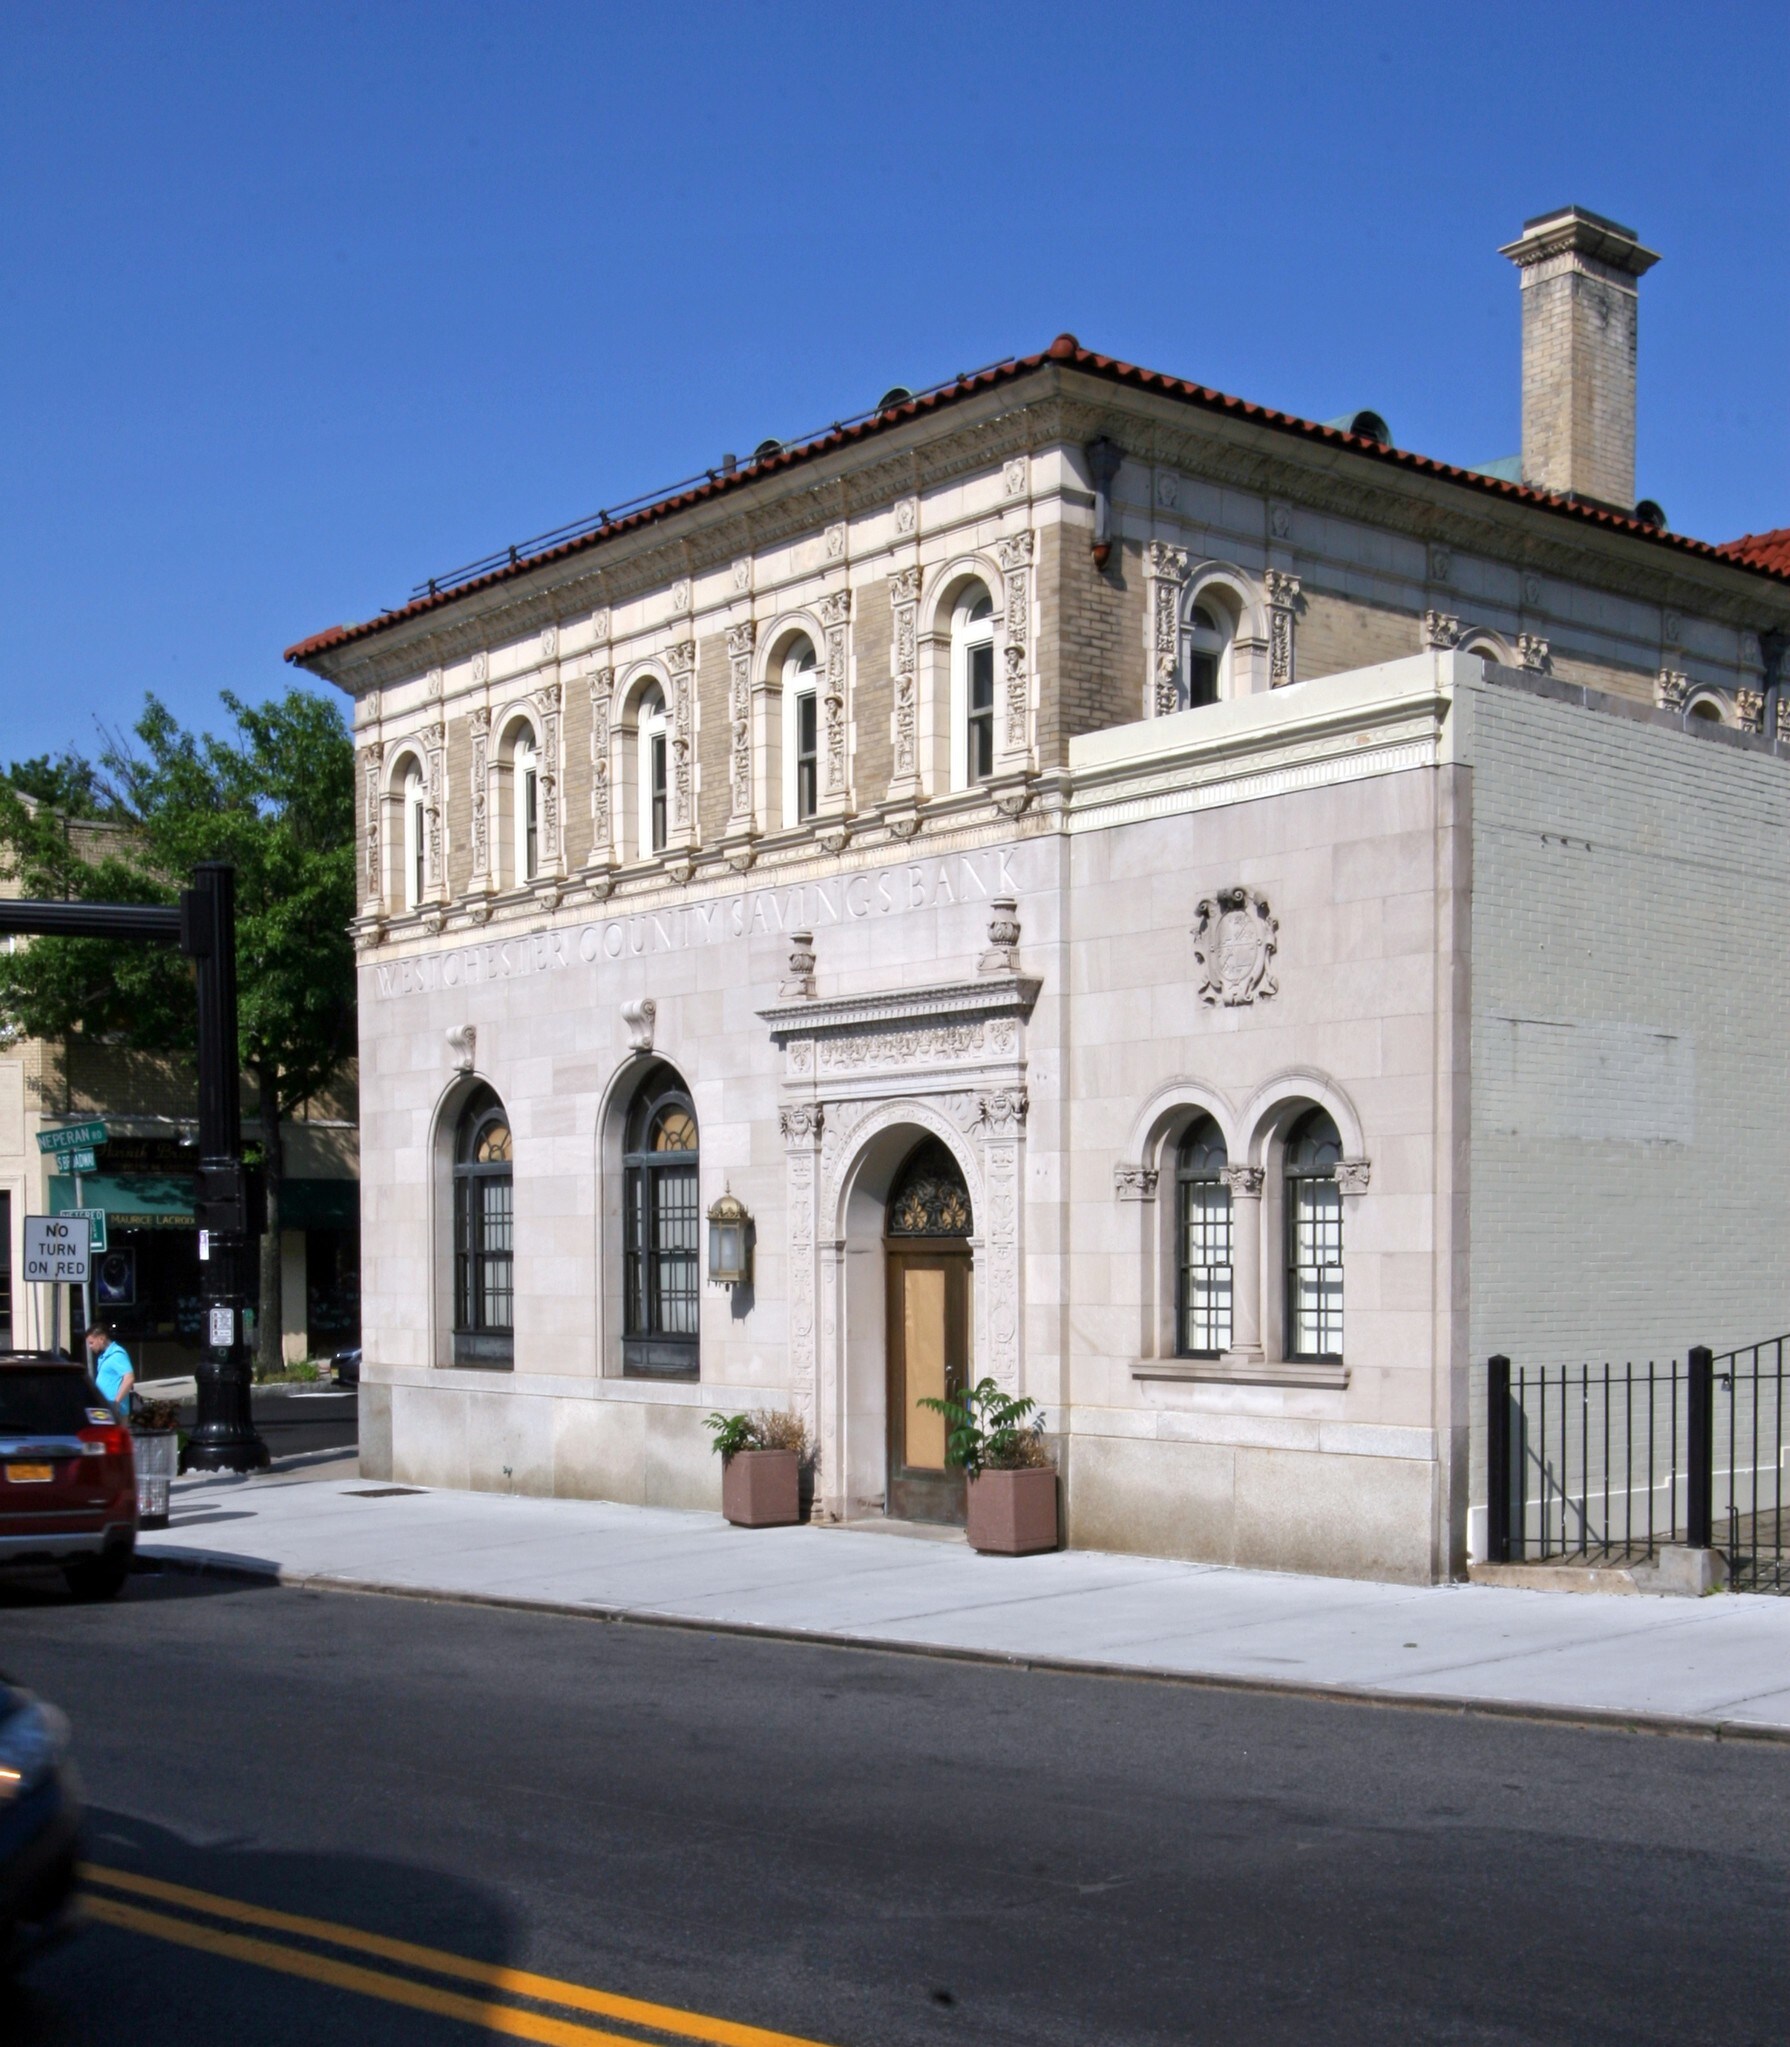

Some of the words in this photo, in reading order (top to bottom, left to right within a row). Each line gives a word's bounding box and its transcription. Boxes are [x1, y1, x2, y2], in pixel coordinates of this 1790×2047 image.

[375, 932, 569, 997] WESTCHESTER
[579, 903, 719, 963] COUNTY
[732, 871, 891, 937] SAVINGS
[907, 847, 1023, 910] BANK
[38, 1127, 90, 1149] NEPERAN
[57, 1156, 62, 1170] S
[63, 1153, 95, 1170] BRADWAY
[111, 1214, 152, 1225] MAURICE
[156, 1215, 196, 1225] LACROIX
[46, 1225, 68, 1238] NO
[39, 1243, 76, 1256] TURN
[28, 1261, 47, 1274] ON
[57, 1262, 85, 1275] RED
